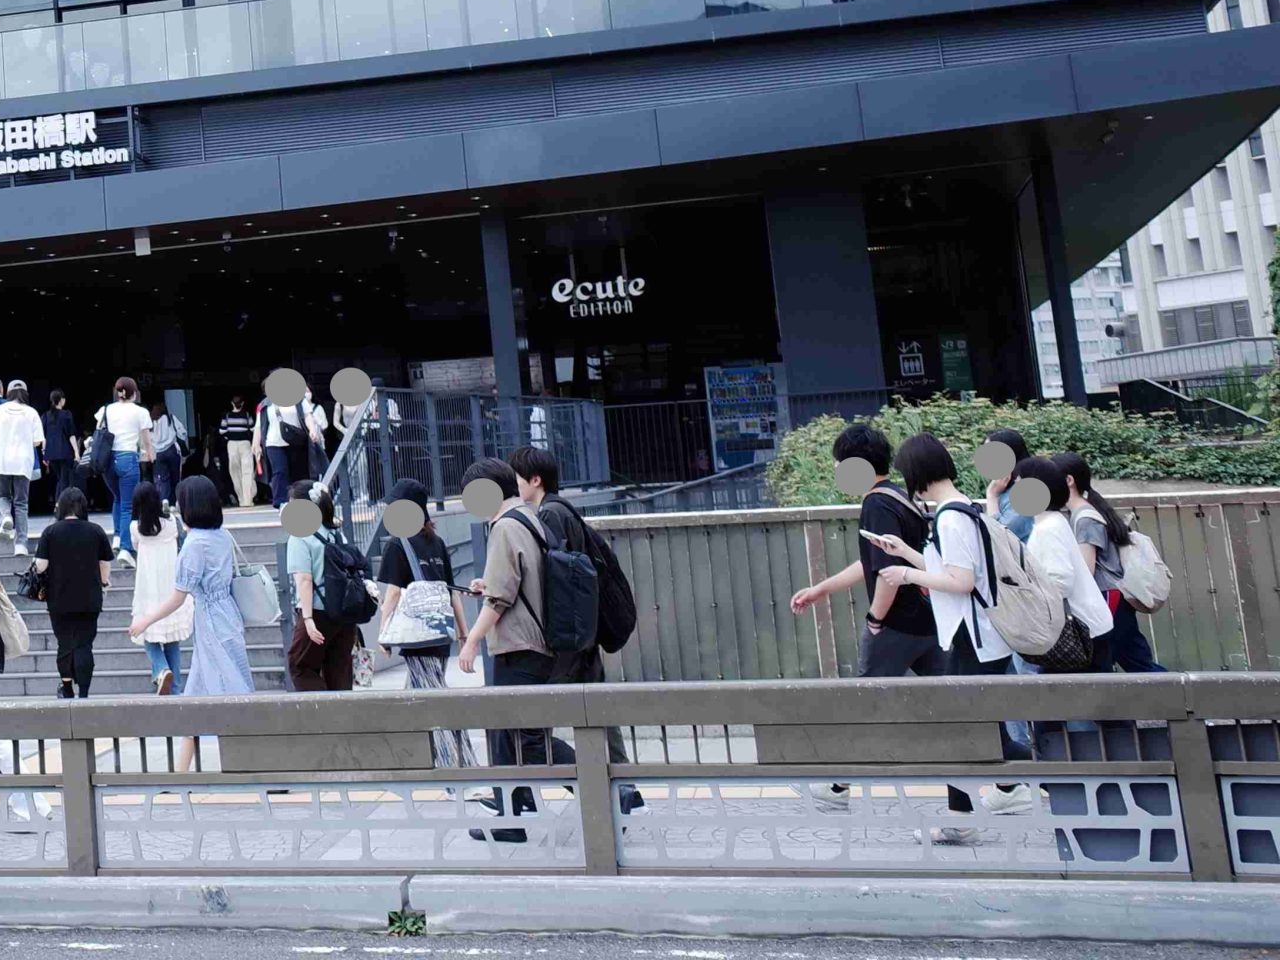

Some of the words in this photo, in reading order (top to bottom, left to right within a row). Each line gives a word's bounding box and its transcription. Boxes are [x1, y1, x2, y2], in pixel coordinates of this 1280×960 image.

[60, 147, 129, 169] Station
[551, 275, 646, 303] ecute
[569, 299, 634, 318] EDITION
